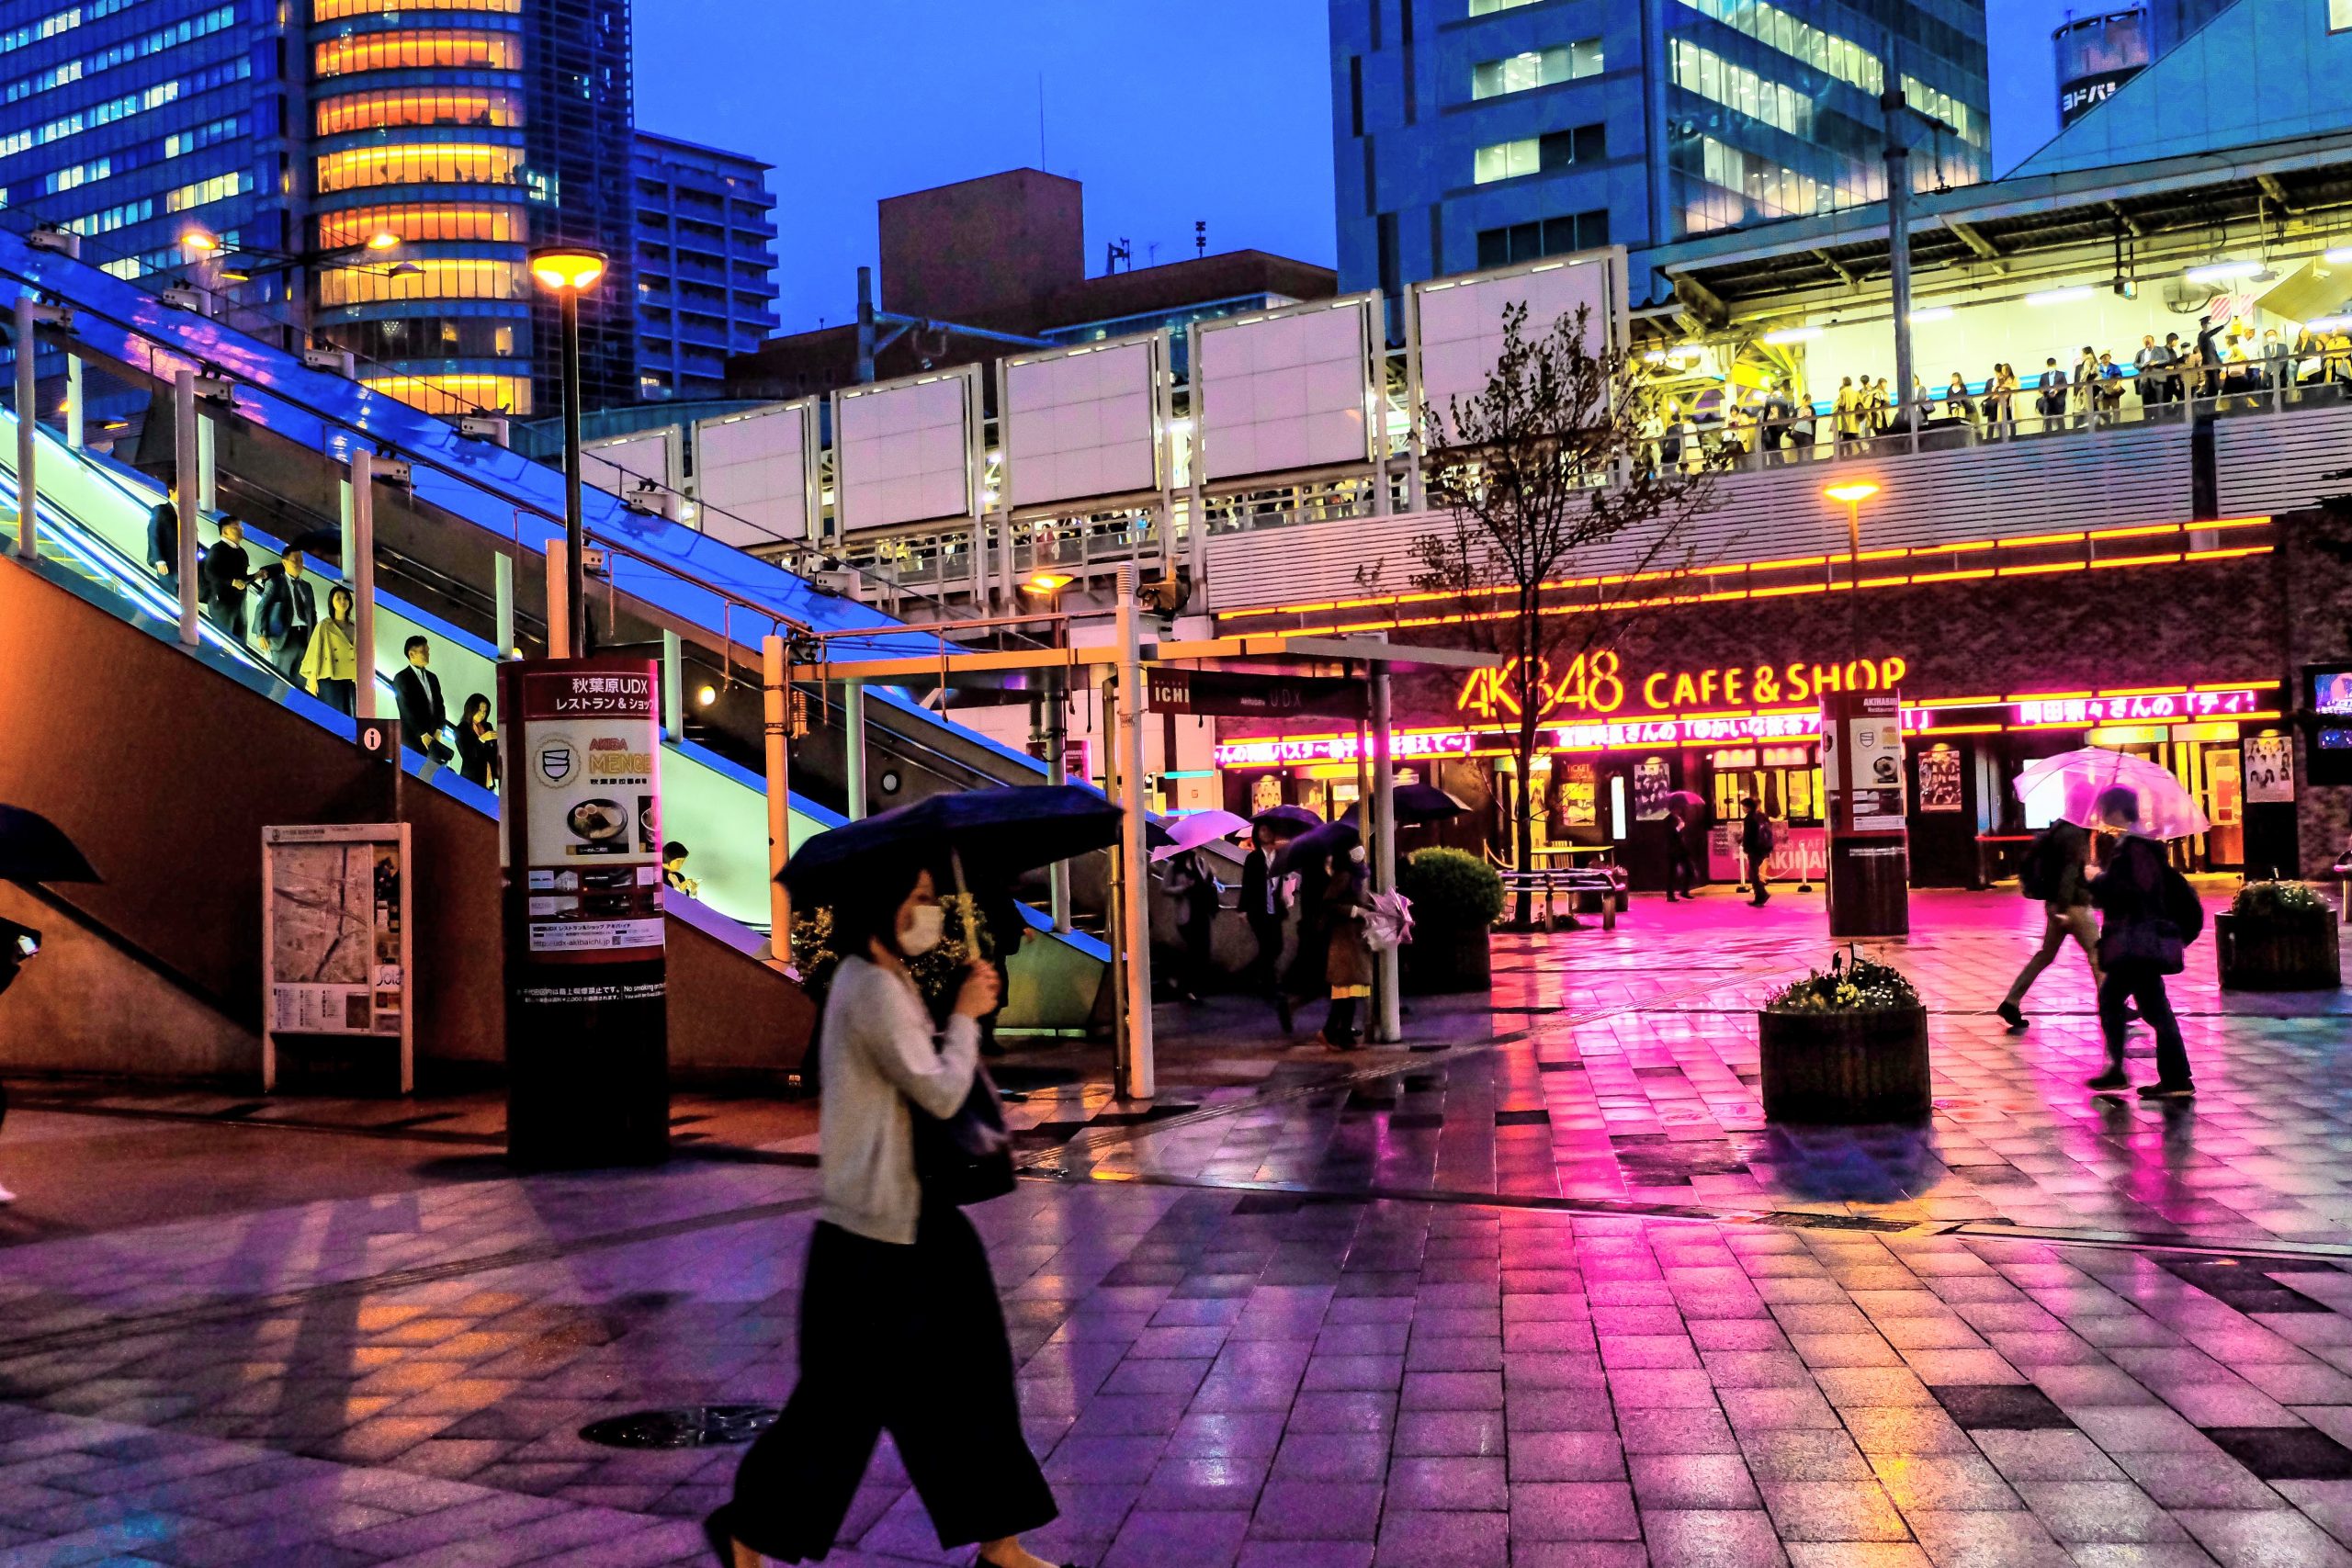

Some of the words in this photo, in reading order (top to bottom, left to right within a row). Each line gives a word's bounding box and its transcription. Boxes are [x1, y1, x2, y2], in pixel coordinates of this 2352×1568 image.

[572, 678, 648, 694] 秋葉原UDX
[1155, 686, 1190, 704] ICHI
[1269, 689, 1301, 707] UDX
[589, 739, 628, 750] AKIBA
[1566, 764, 1590, 773] TICKET
[633, 984, 654, 992] smoking
